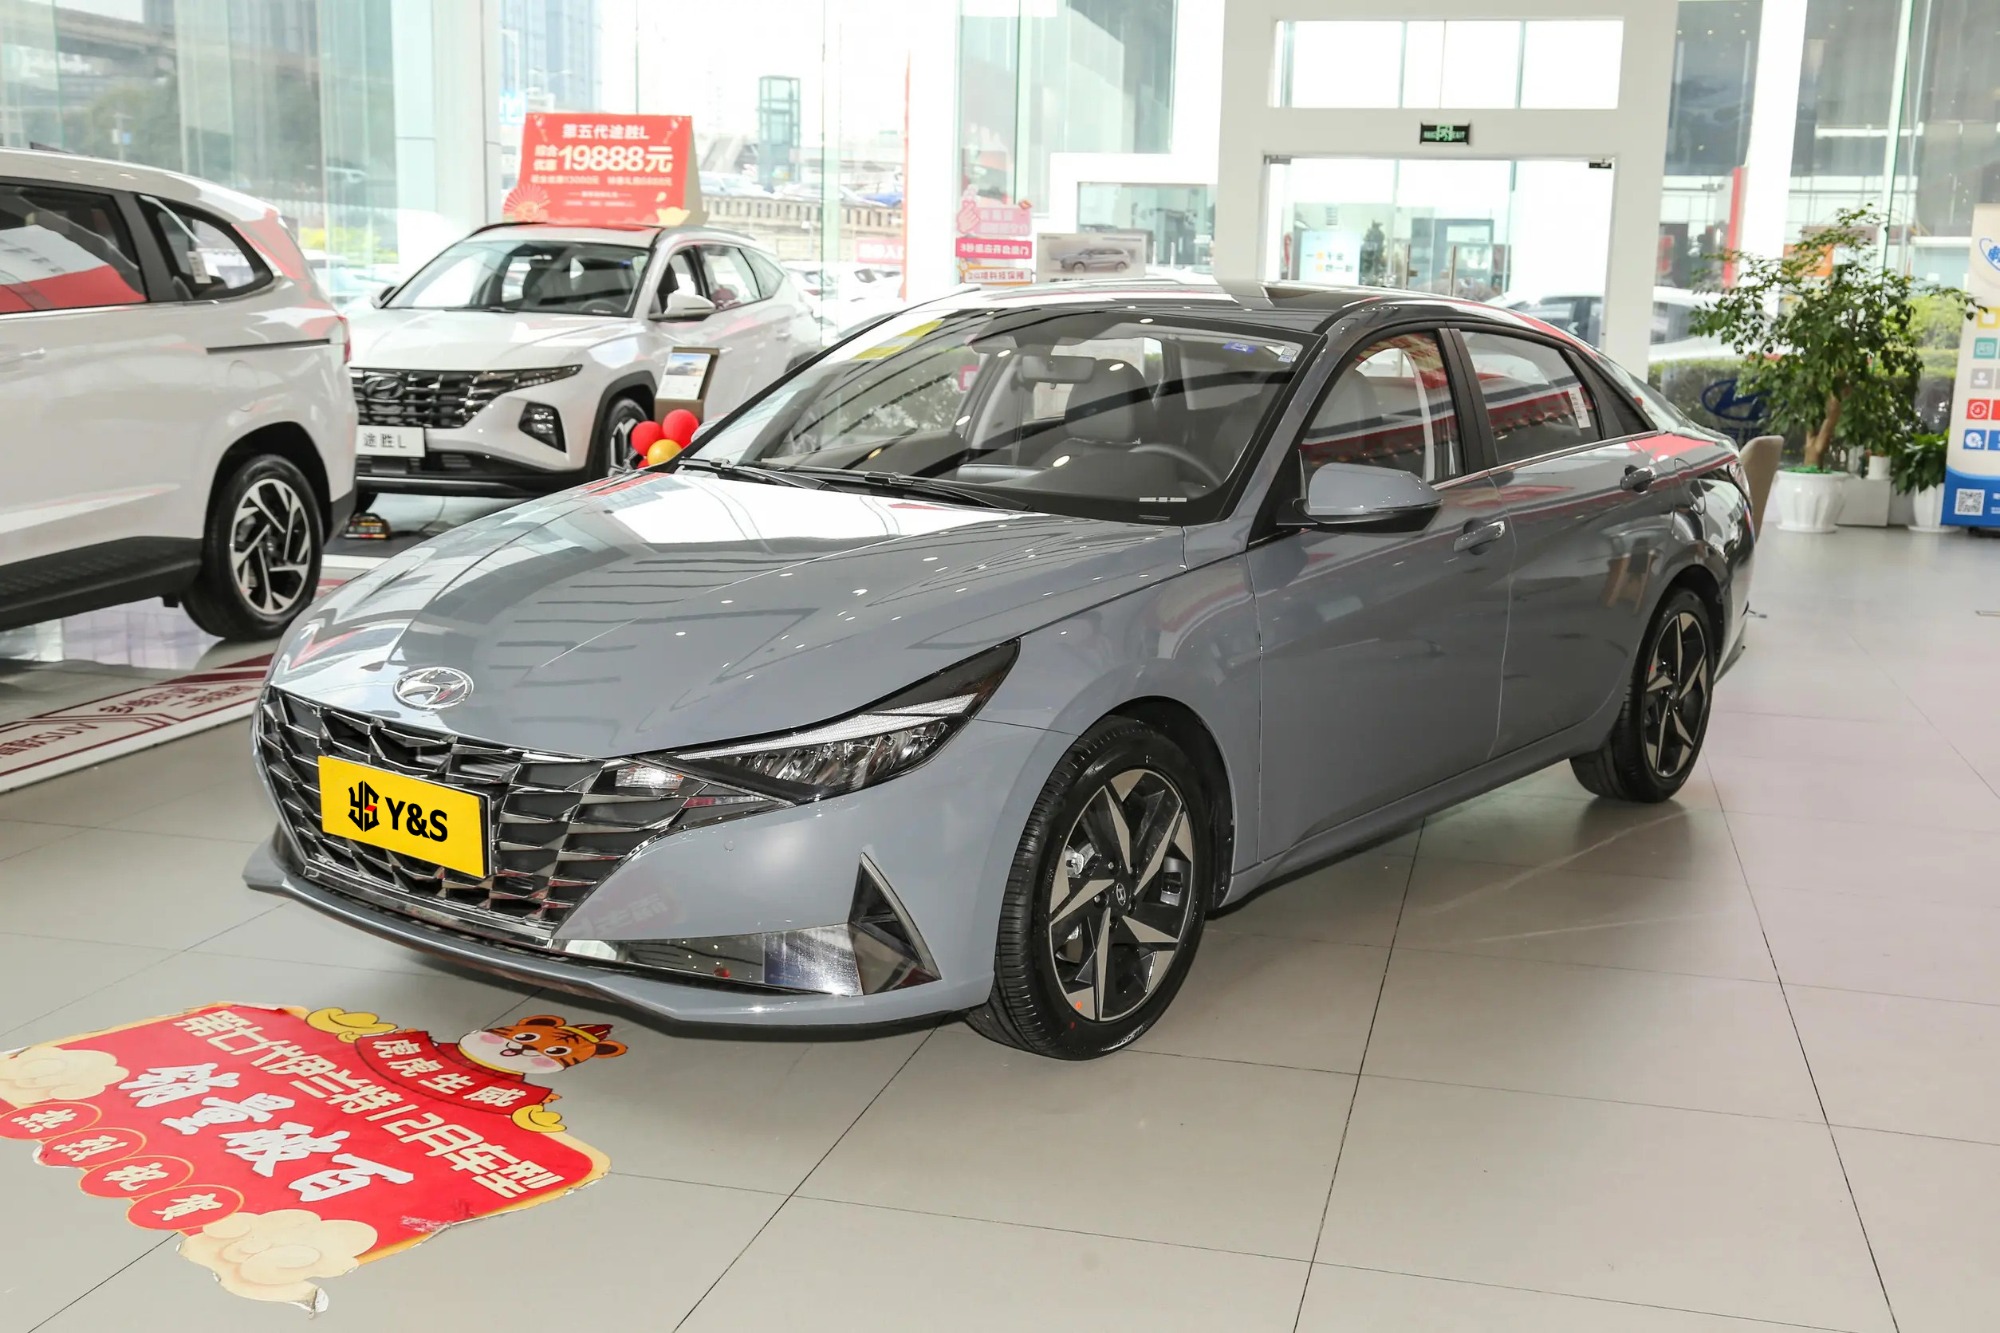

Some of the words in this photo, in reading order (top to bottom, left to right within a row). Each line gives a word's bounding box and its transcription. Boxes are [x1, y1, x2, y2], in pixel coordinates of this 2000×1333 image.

[558, 145, 673, 173] 19888元
[372, 1039, 526, 1108] 虎虎生威
[11, 1108, 223, 1211] 热烈祝贺
[119, 1062, 414, 1202] 销量破百
